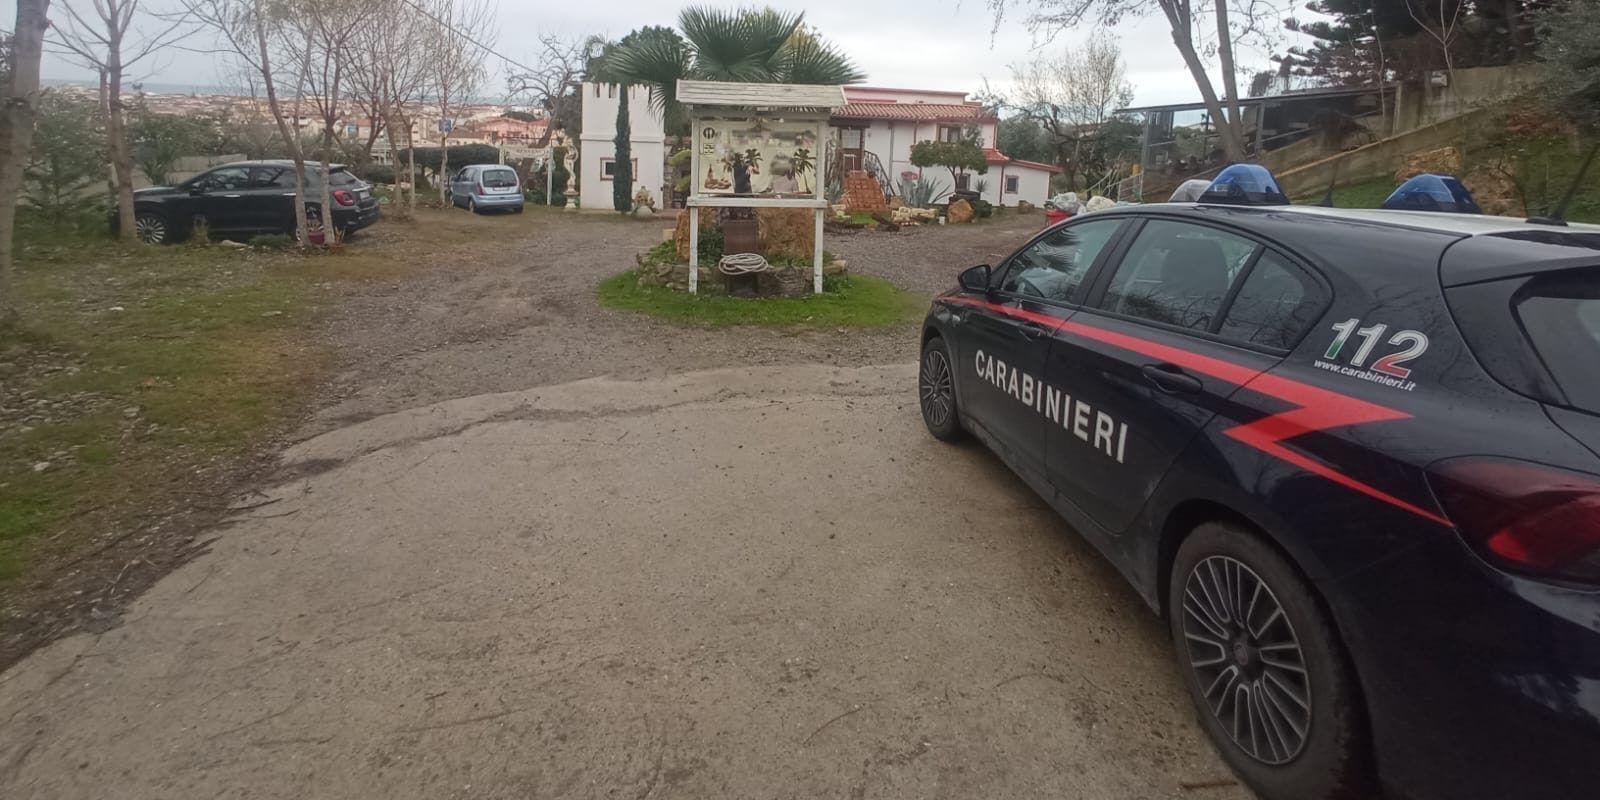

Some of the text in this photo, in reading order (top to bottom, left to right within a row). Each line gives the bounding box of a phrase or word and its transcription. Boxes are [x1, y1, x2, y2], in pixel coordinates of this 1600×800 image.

[1314, 359, 1416, 392] www.carabinieri.it
[1324, 318, 1429, 379] 112
[975, 349, 1128, 464] CARABINIERI
